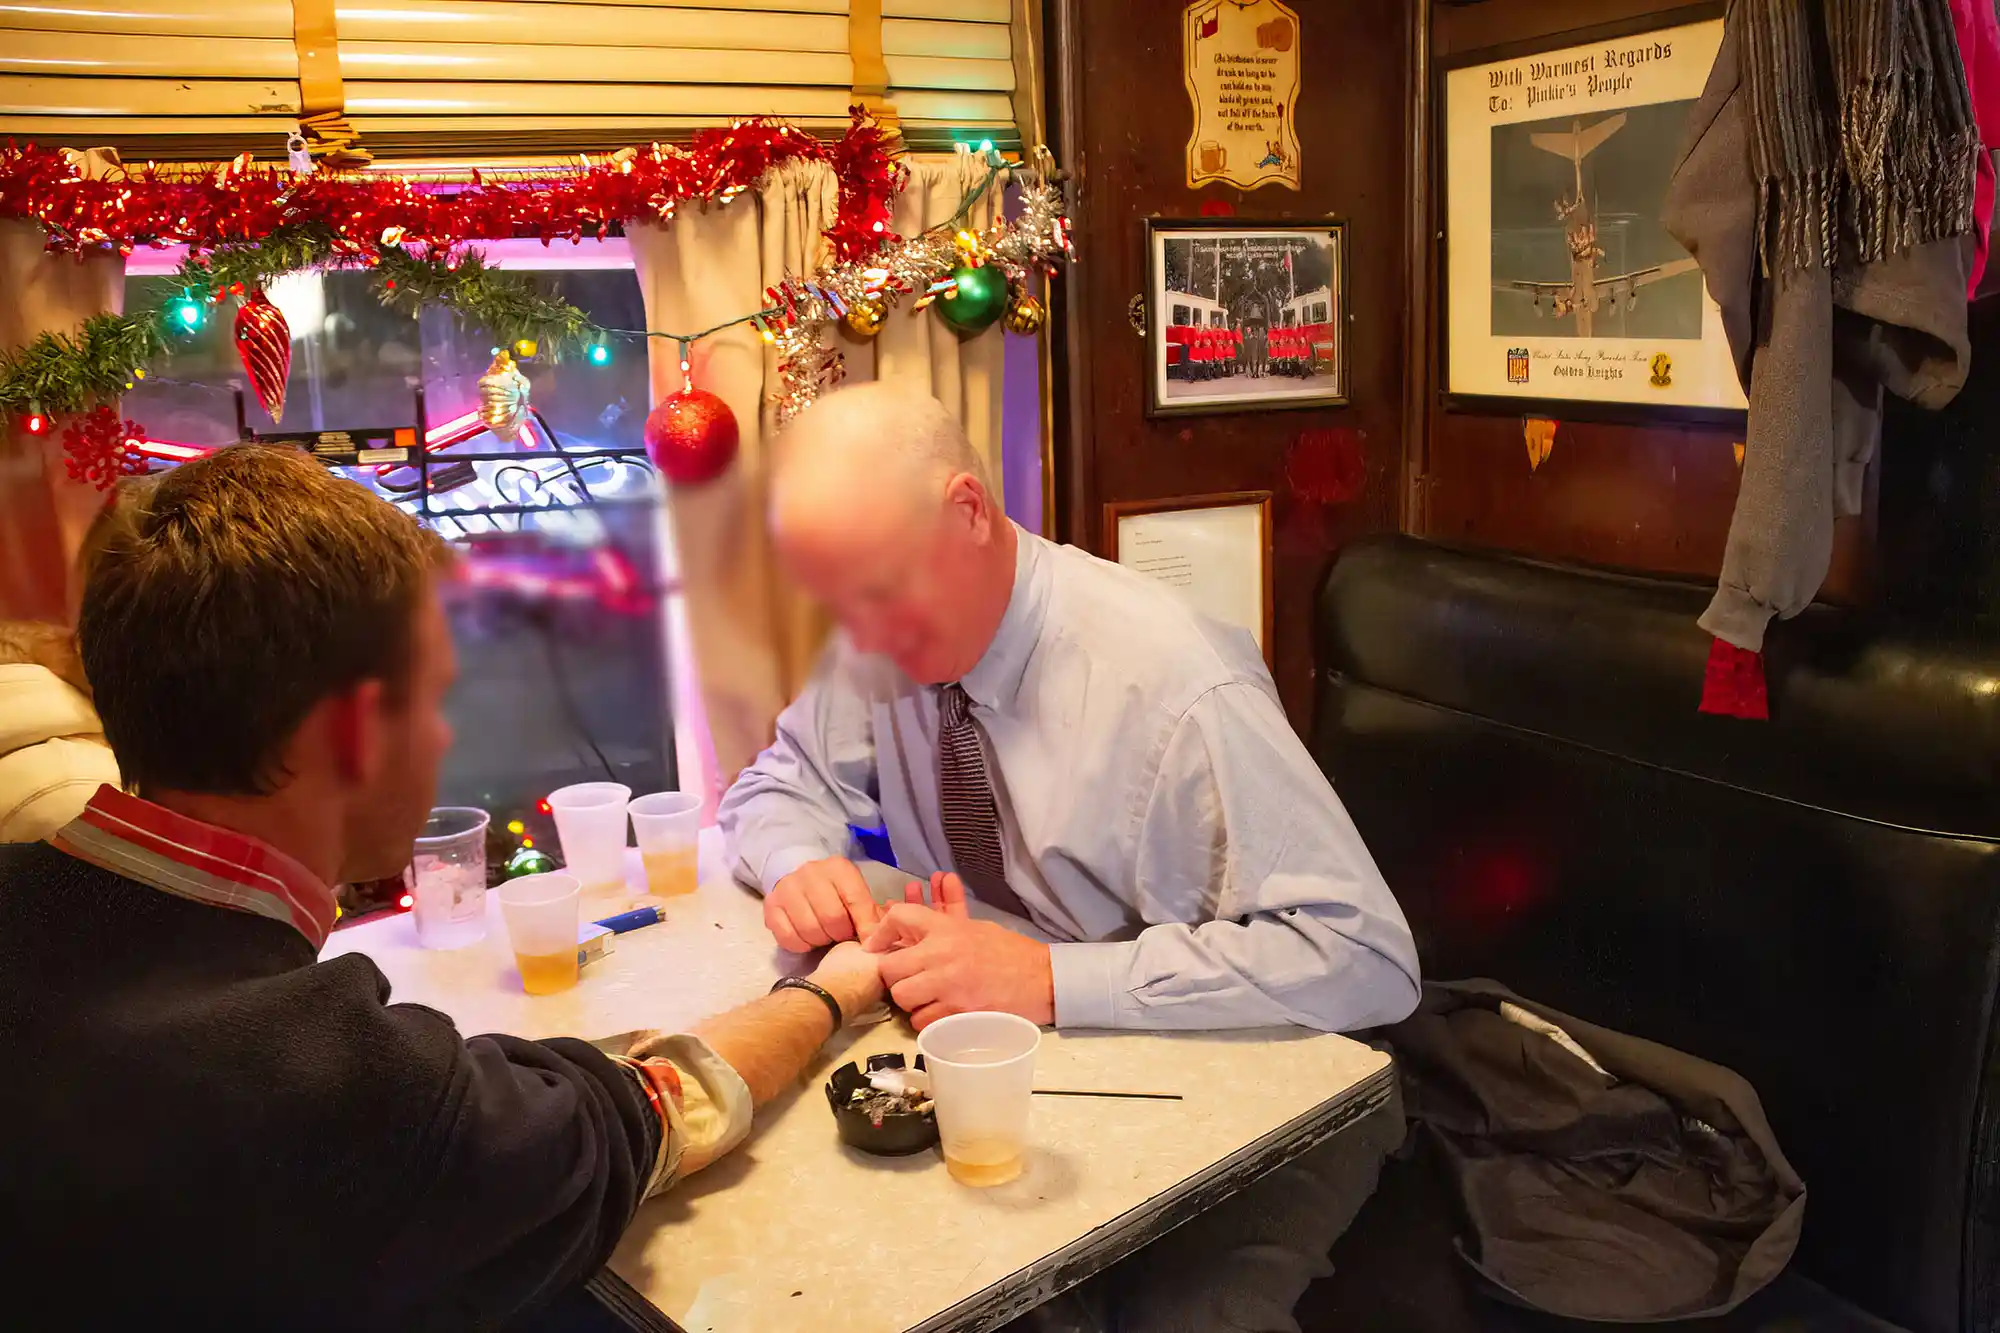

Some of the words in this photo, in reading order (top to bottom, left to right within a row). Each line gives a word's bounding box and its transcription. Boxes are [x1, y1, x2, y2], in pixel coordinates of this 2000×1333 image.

[1488, 67, 1522, 88] With
[1530, 55, 1595, 81] Warmest
[1604, 42, 1672, 69] Regards
[1488, 96, 1513, 113] To:
[1527, 83, 1576, 108] Pinkie's
[1588, 72, 1633, 97] People
[1553, 365, 1584, 377] Golden
[1587, 365, 1623, 380] Knights
